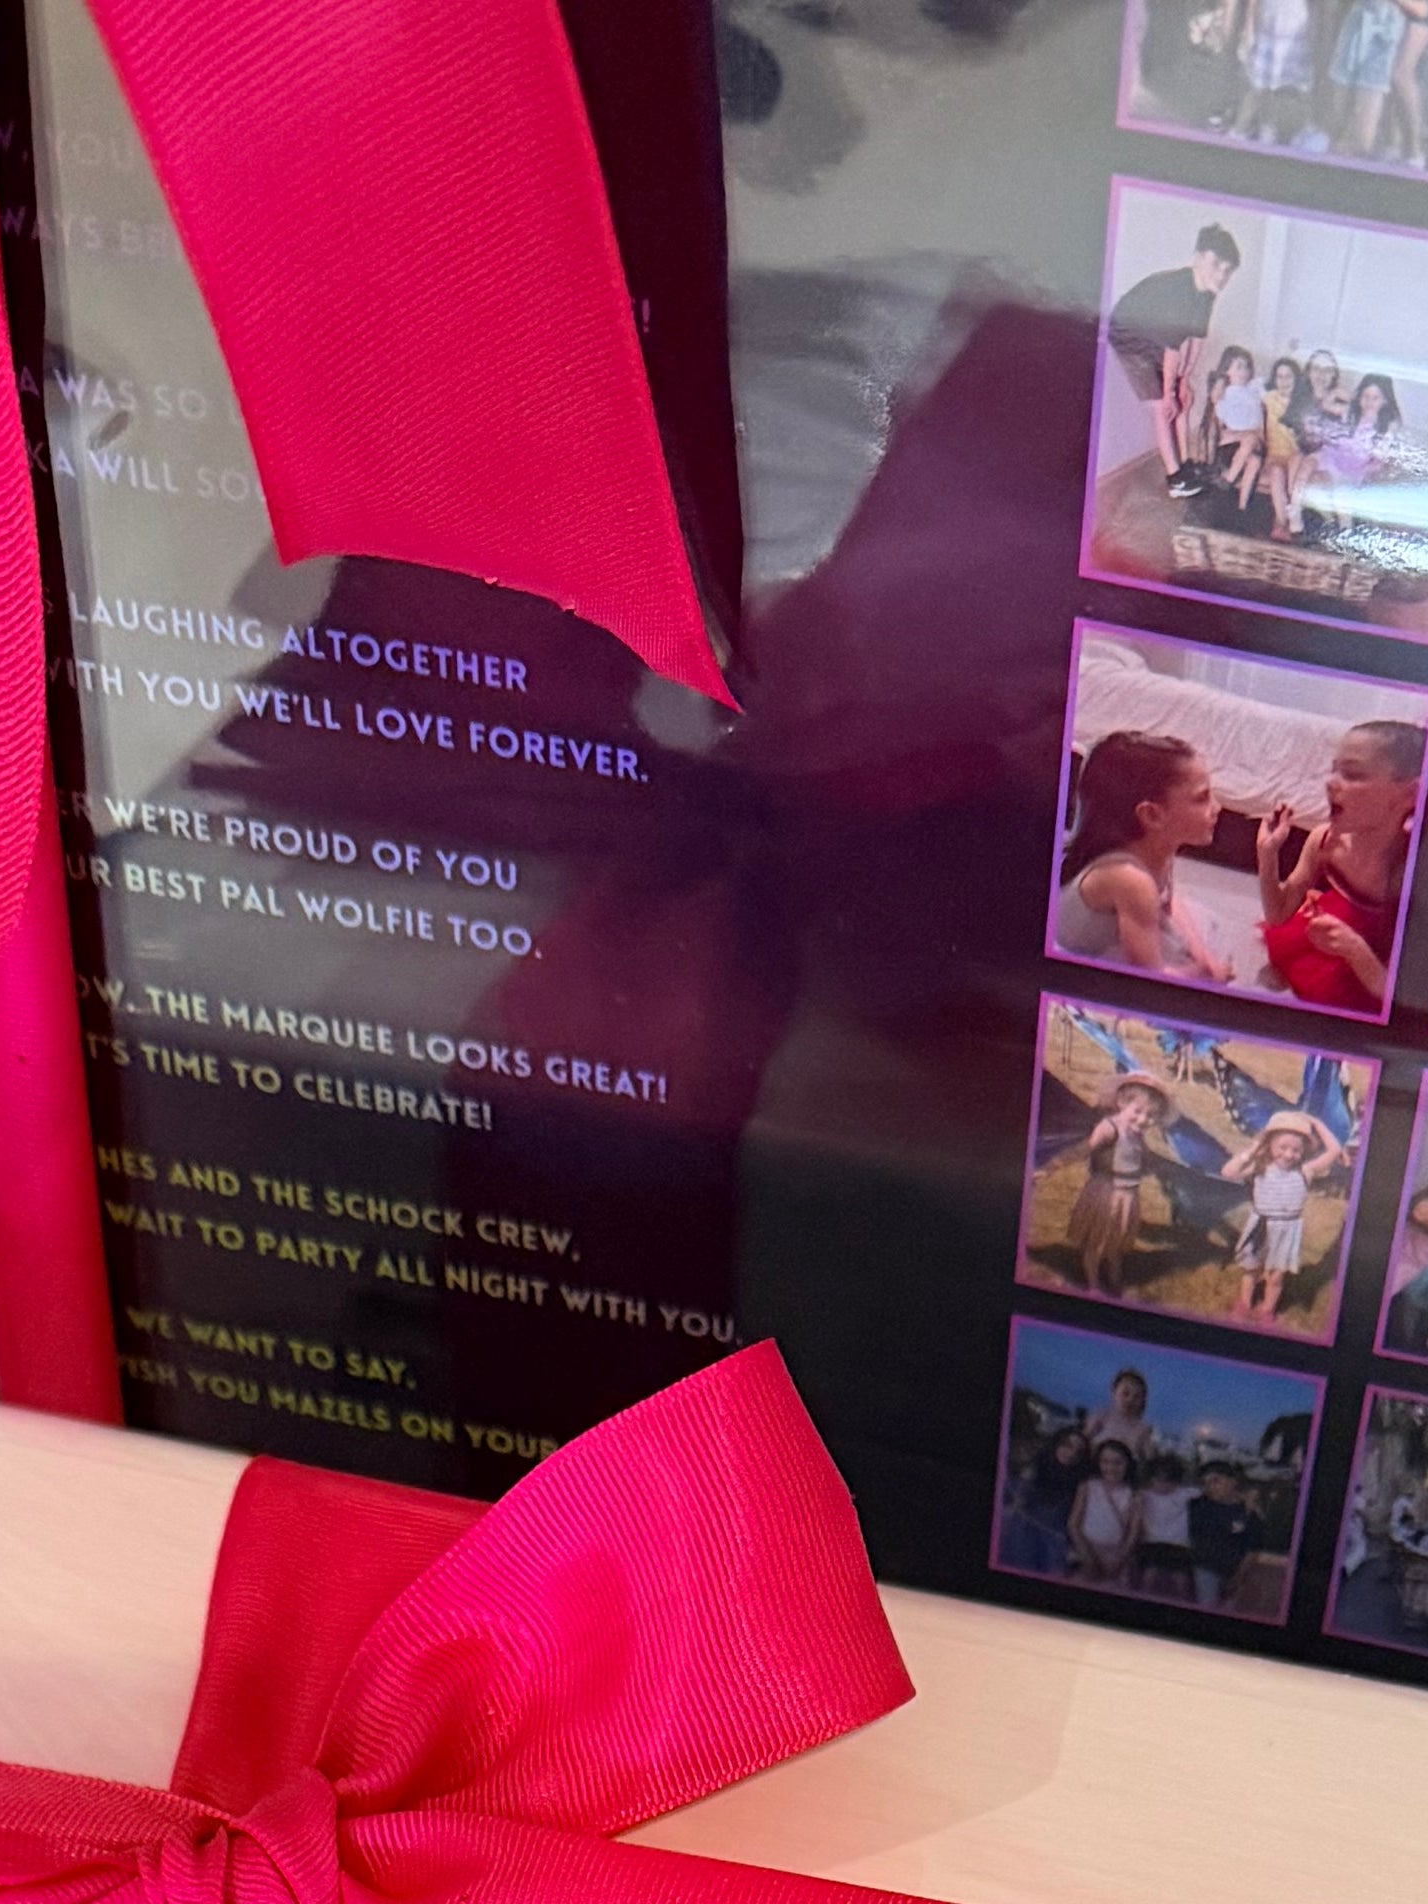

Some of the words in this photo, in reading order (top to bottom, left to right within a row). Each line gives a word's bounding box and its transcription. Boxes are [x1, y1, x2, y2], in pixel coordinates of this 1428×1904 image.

[53, 368, 136, 411] WAS
[88, 448, 179, 494] WILL
[70, 591, 265, 650] LAUGHING
[279, 624, 528, 694] ALTOGETHER
[138, 670, 222, 713] YOU
[234, 683, 342, 731] WE'LL
[354, 700, 456, 752] LOVE
[468, 720, 649, 783] FOREVER.
[104, 797, 212, 843] WE'RE
[223, 815, 358, 865] PROUD
[371, 839, 422, 876] OF
[435, 848, 518, 892] YOU
[122, 861, 208, 905] BEST
[219, 877, 287, 919] PAL
[294, 887, 435, 942] WOLFIE
[446, 910, 543, 960] TOO.
[137, 1041, 221, 1085] TIME
[228, 1056, 283, 1094] TO
[293, 1072, 493, 1132] CELEBRATE!
[144, 983, 211, 1026] THE
[220, 997, 394, 1057] MARQUEE
[405, 1024, 533, 1079] LOOKS
[543, 1051, 669, 1104] GREAT!
[167, 1160, 242, 1198] AND
[250, 1174, 314, 1213] THE
[323, 1185, 465, 1239] SCHOCK
[105, 1200, 186, 1240] WAIT
[195, 1218, 245, 1252] TO
[254, 1226, 363, 1275] PARTY
[375, 1249, 433, 1288] ALL
[444, 1258, 549, 1307] NIGHT
[558, 1282, 648, 1329] WITH
[180, 1313, 278, 1360] WANT
[287, 1332, 337, 1372] TO
[187, 1365, 261, 1405] YOU
[266, 1381, 392, 1433] MAZELS
[400, 1409, 453, 1444] ON
